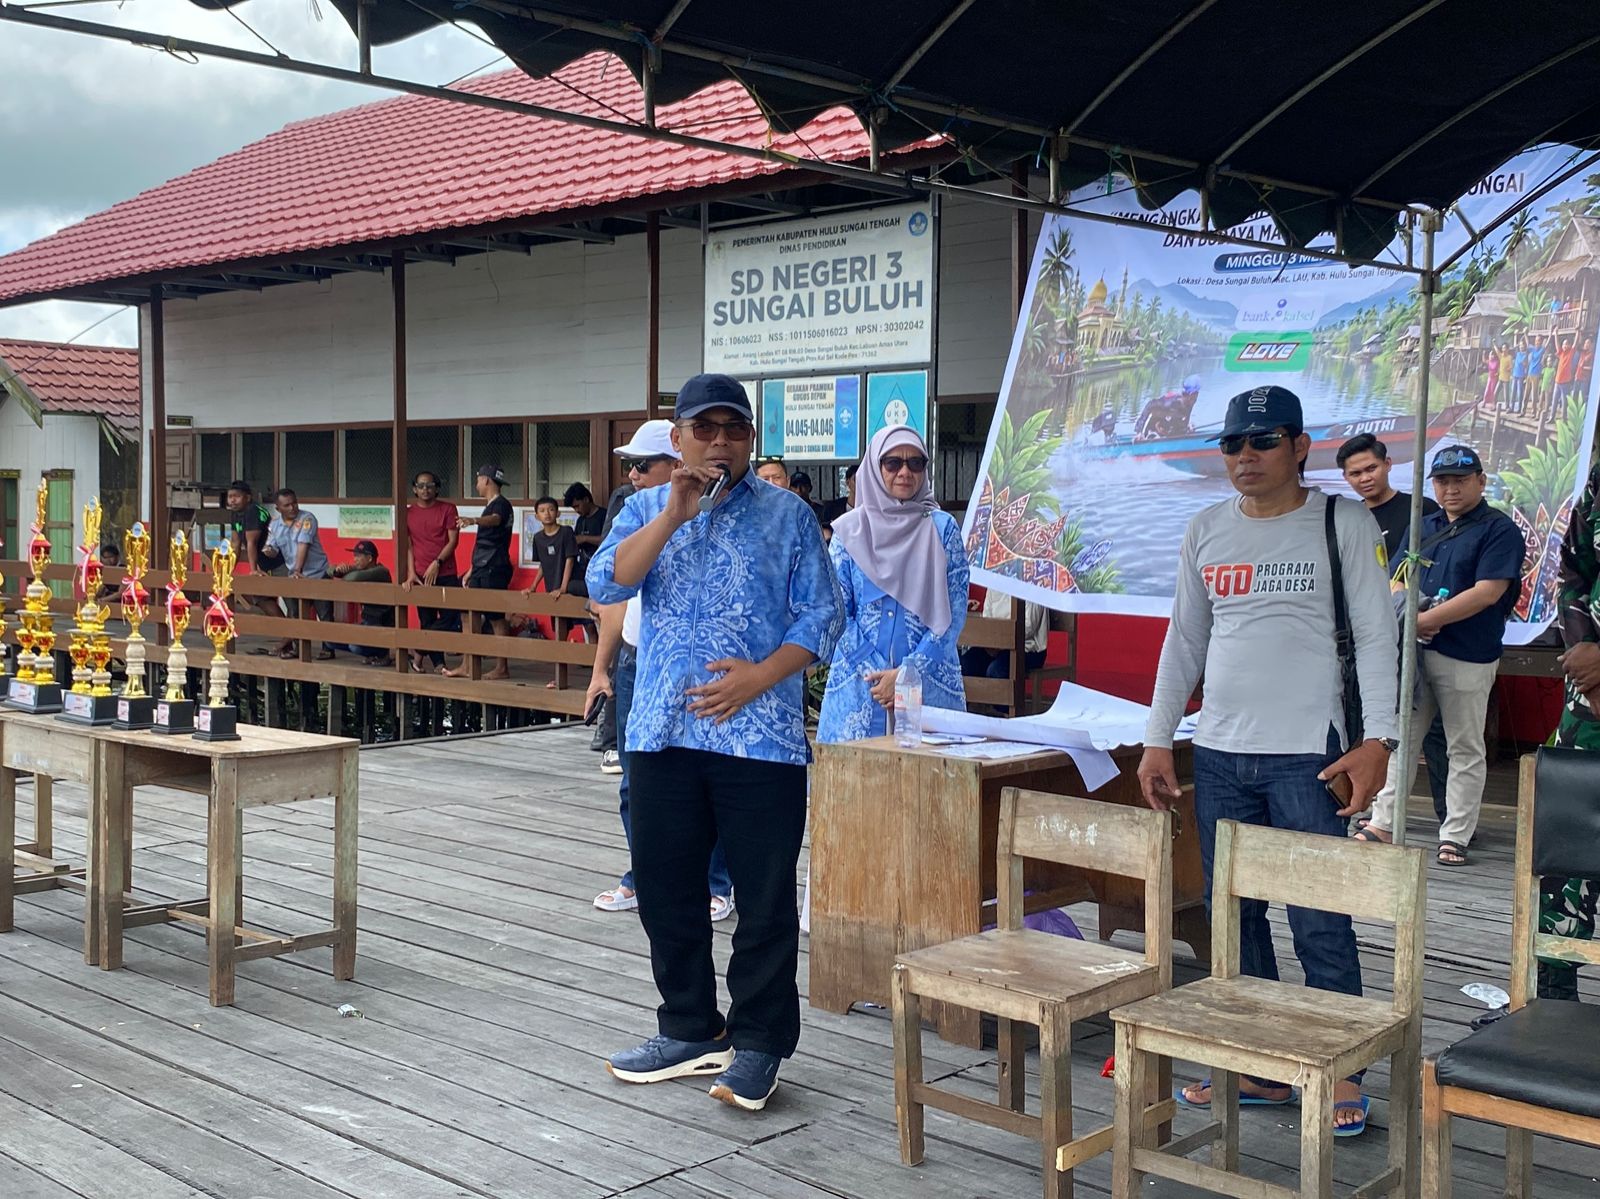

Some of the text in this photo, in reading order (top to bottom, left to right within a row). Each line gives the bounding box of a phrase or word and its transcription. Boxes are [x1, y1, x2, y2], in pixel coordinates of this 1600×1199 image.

[1467, 172, 1524, 196] UNGAI
[732, 217, 900, 248] PEMERINTAH KABUPATEN HULU SUNGAI TENGAH
[1163, 234, 1193, 247] DAN
[780, 238, 847, 254] DINAS PENDIDIKAN
[1226, 253, 1284, 268] MINGGU,
[731, 251, 902, 296] SD NEGERI 3
[1177, 276, 1200, 284] Lokasi
[1225, 277, 1249, 286] Sungai
[1292, 274, 1309, 282] LAU,
[1311, 272, 1328, 280] Kab.
[1349, 269, 1374, 279] Sungai
[713, 280, 922, 326] SUNGAI BULUH
[1242, 310, 1315, 321] bank kalsel
[712, 338, 723, 346] NIS
[729, 334, 761, 344] 10606023
[769, 333, 783, 342] NSS
[790, 327, 848, 340] 1011506016023
[856, 324, 878, 334] NPSN
[884, 320, 924, 331] 30302042
[1238, 342, 1298, 360] LOVE
[786, 418, 833, 436] 04.045-04.046
[1343, 418, 1397, 435] 2 PUTRI
[1256, 562, 1315, 577] PROGRAM
[1254, 578, 1315, 592] JAGA DESA
